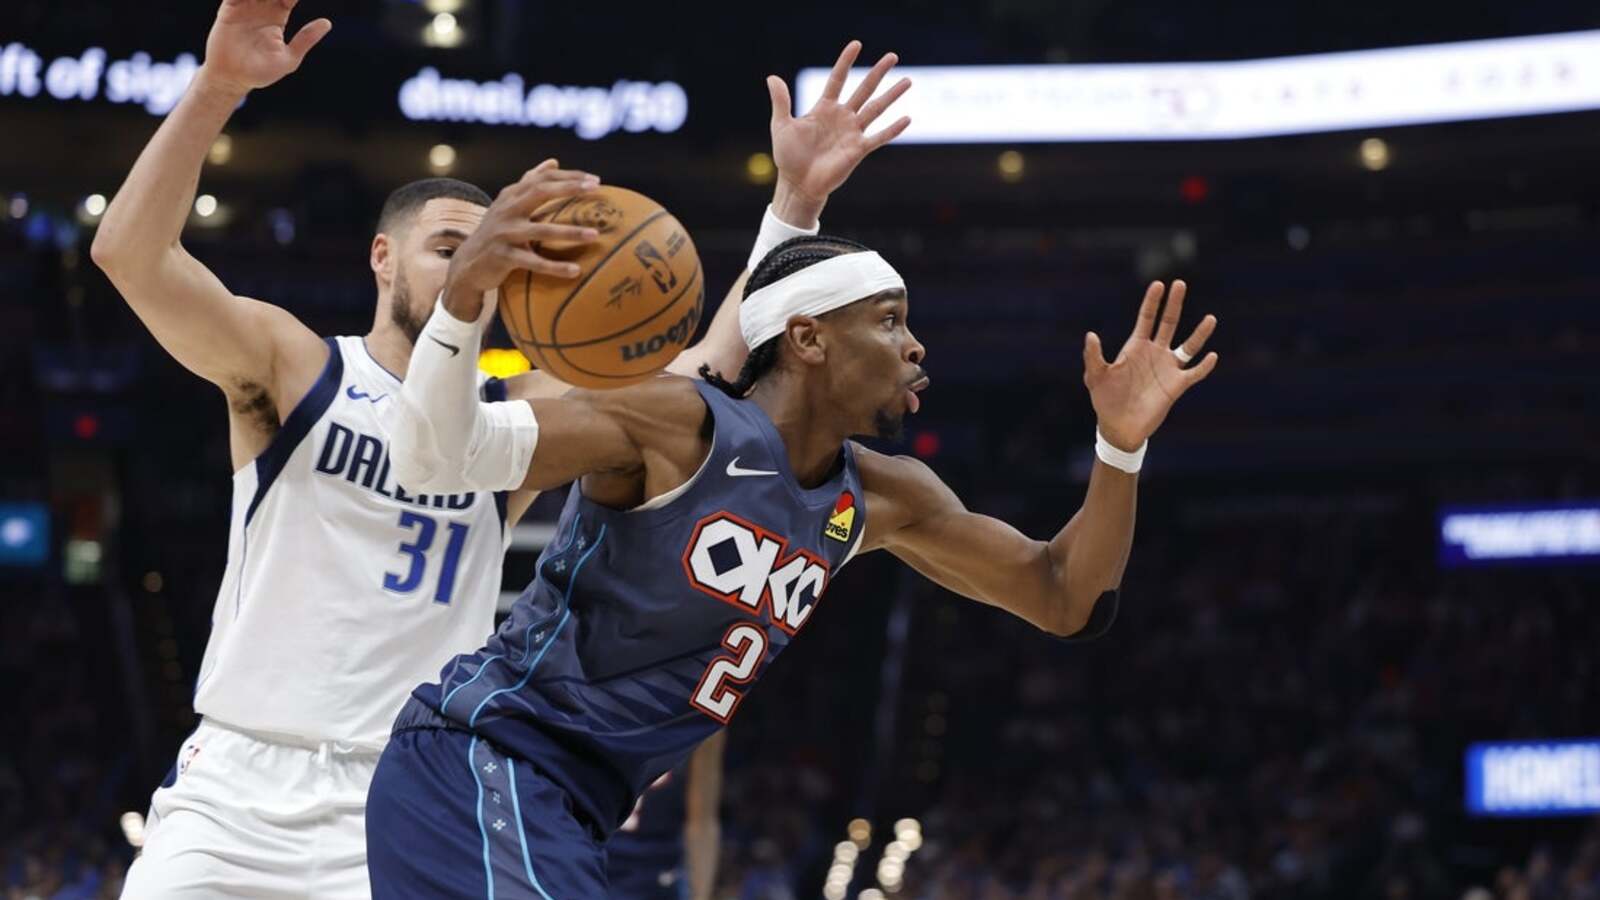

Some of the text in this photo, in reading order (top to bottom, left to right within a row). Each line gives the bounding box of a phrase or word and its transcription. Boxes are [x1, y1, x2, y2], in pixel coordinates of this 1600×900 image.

[46, 47, 106, 100] of
[382, 511, 472, 604] 31
[684, 513, 828, 634] OKC
[691, 624, 768, 723] 2
